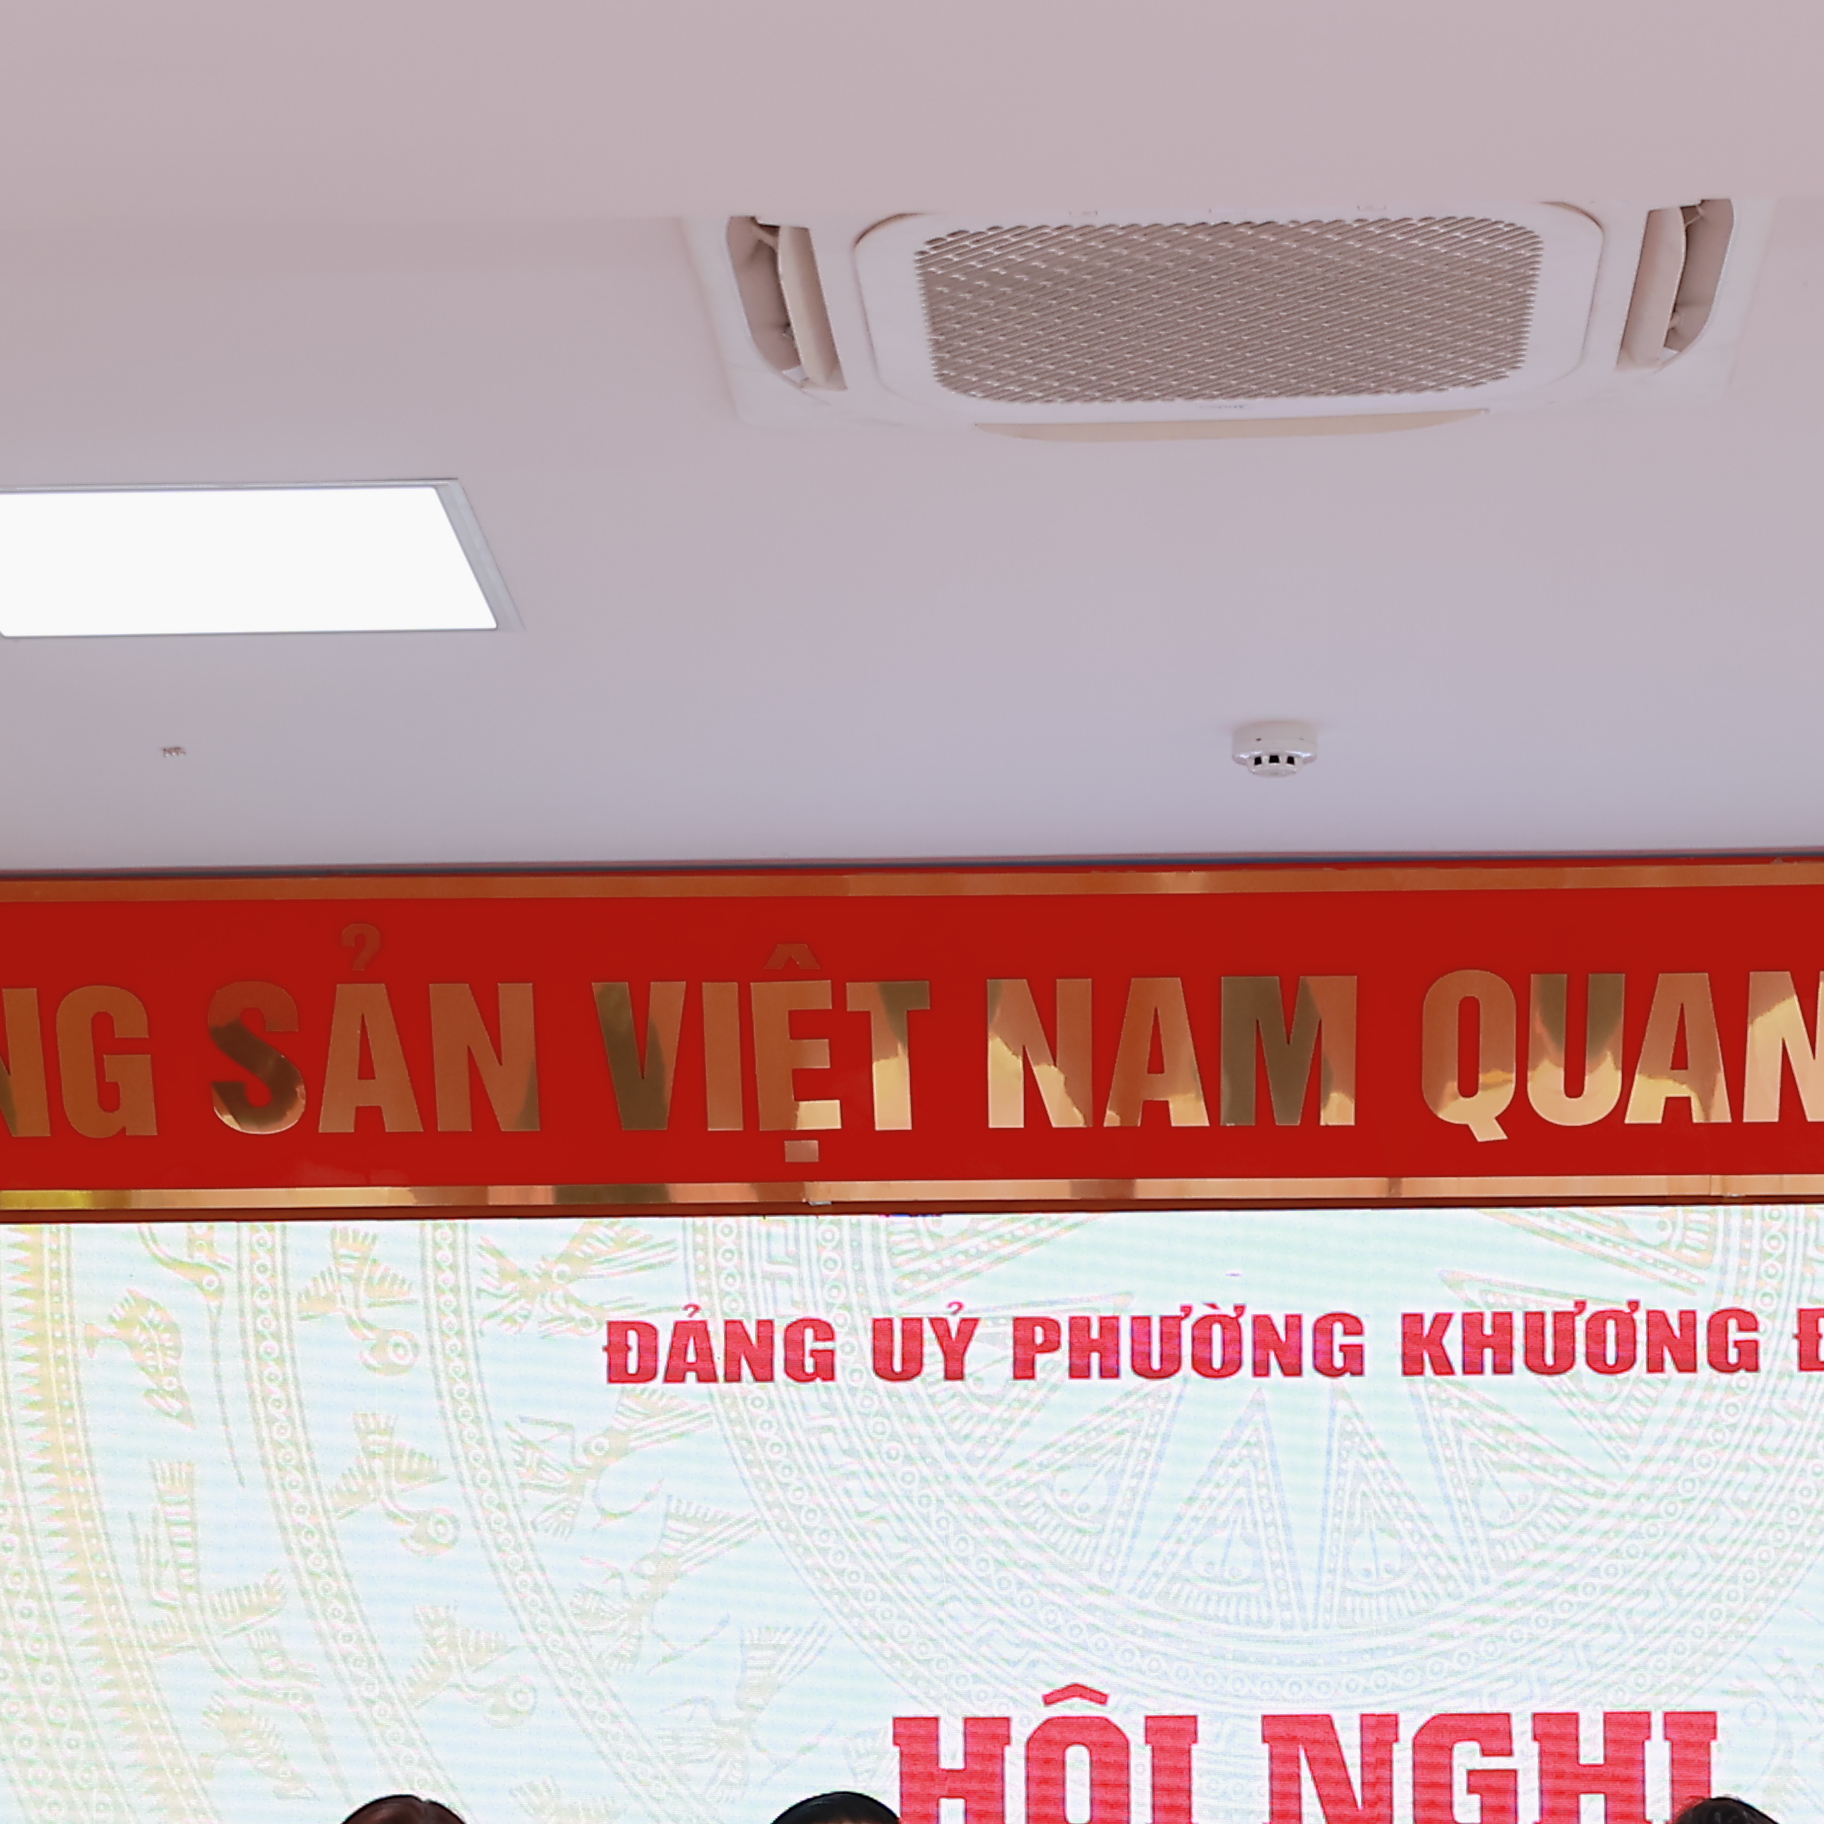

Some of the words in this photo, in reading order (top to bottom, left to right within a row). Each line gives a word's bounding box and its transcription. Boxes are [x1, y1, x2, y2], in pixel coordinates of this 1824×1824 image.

[206, 922, 541, 1134] SẢN
[591, 943, 930, 1162] VIỆT
[987, 975, 1357, 1129] NAM
[603, 1302, 836, 1384] ĐẢNG
[871, 1301, 977, 1381] UỶ
[1011, 1302, 1365, 1380] PHƯỜNG
[1401, 1299, 1759, 1376] KHƯƠNG
